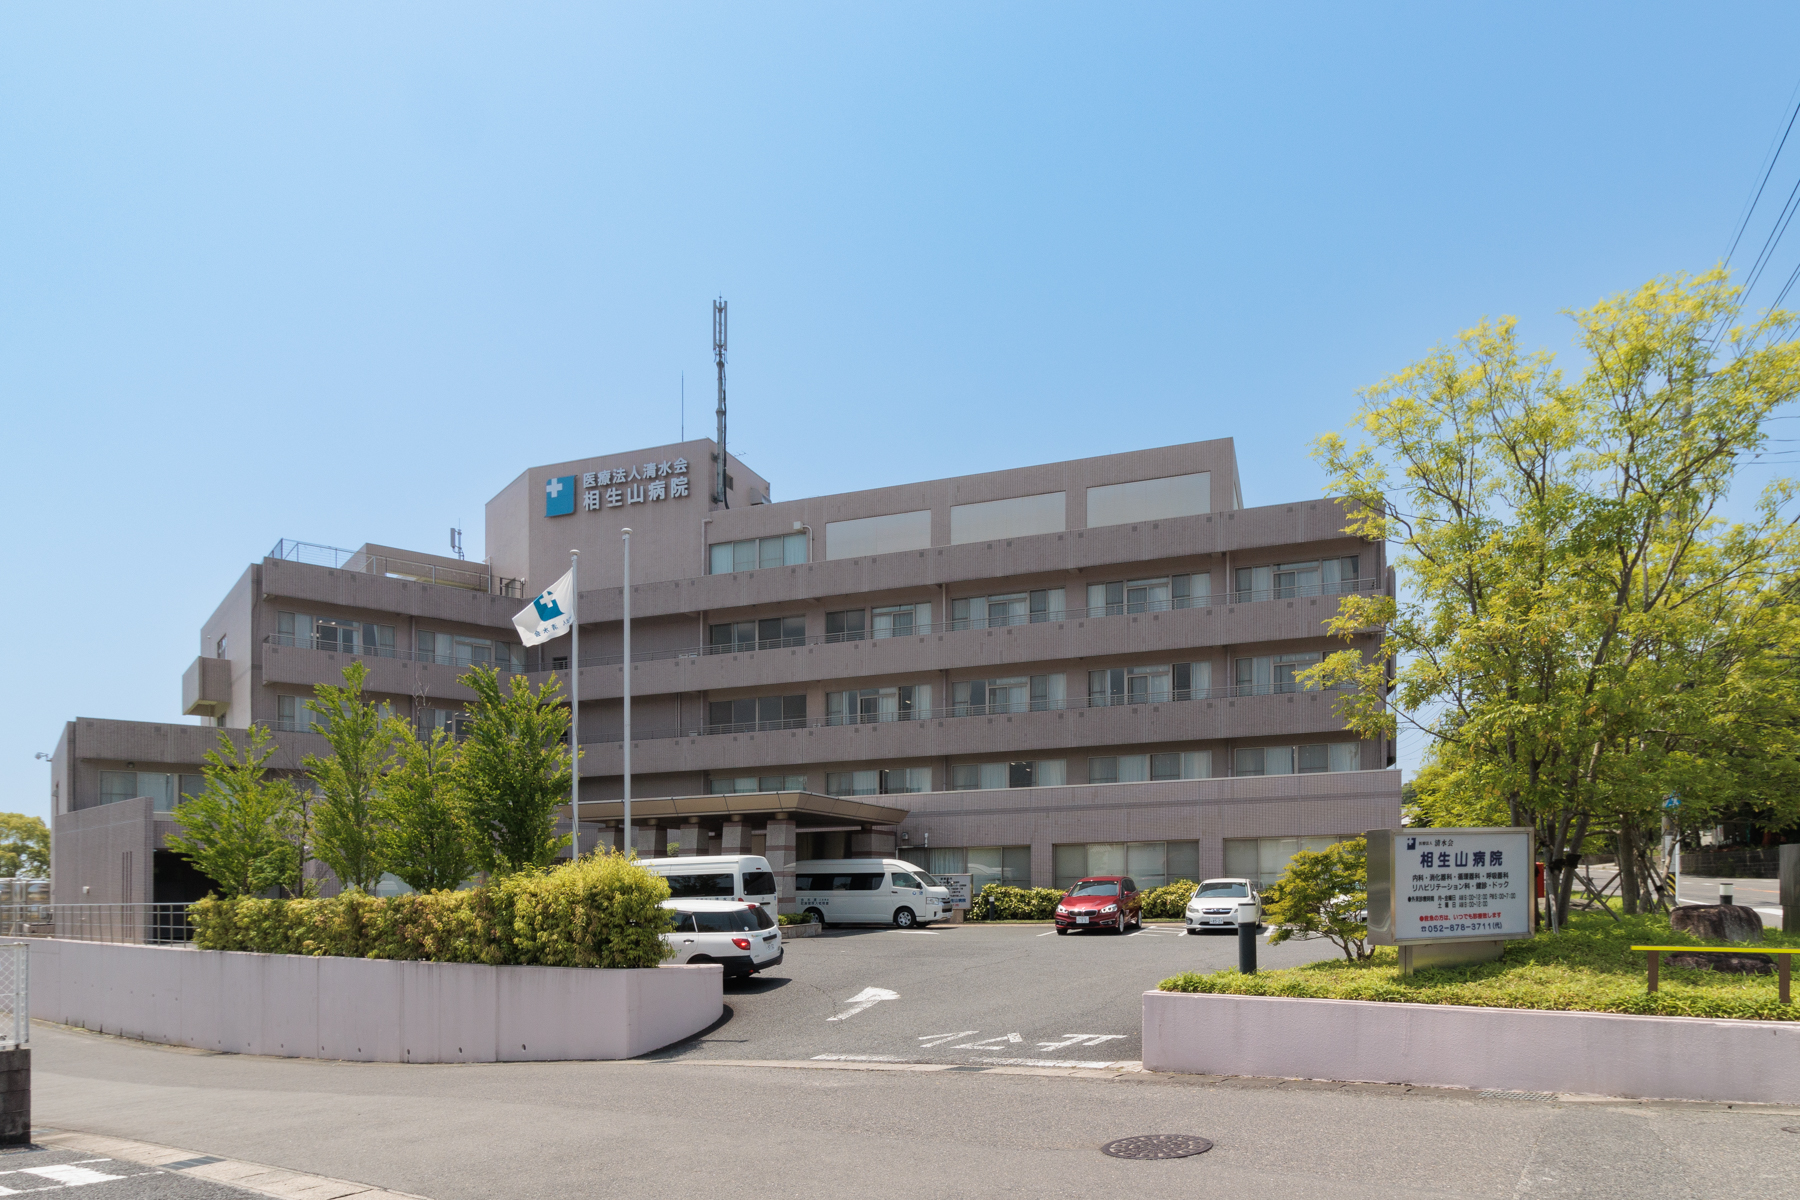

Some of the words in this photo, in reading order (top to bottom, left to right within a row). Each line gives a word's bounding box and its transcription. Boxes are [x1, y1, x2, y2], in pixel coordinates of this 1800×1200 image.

[583, 457, 688, 488] 医療法人清水会
[583, 476, 688, 511] 相生山病院
[1434, 839, 1454, 847] 清水会
[1420, 850, 1503, 868] 相生山病院
[1412, 872, 1509, 882] 内科・消化器科・循環器科・呼吸器科
[1412, 881, 1509, 892] リハビリテーション科・健診・ドック
